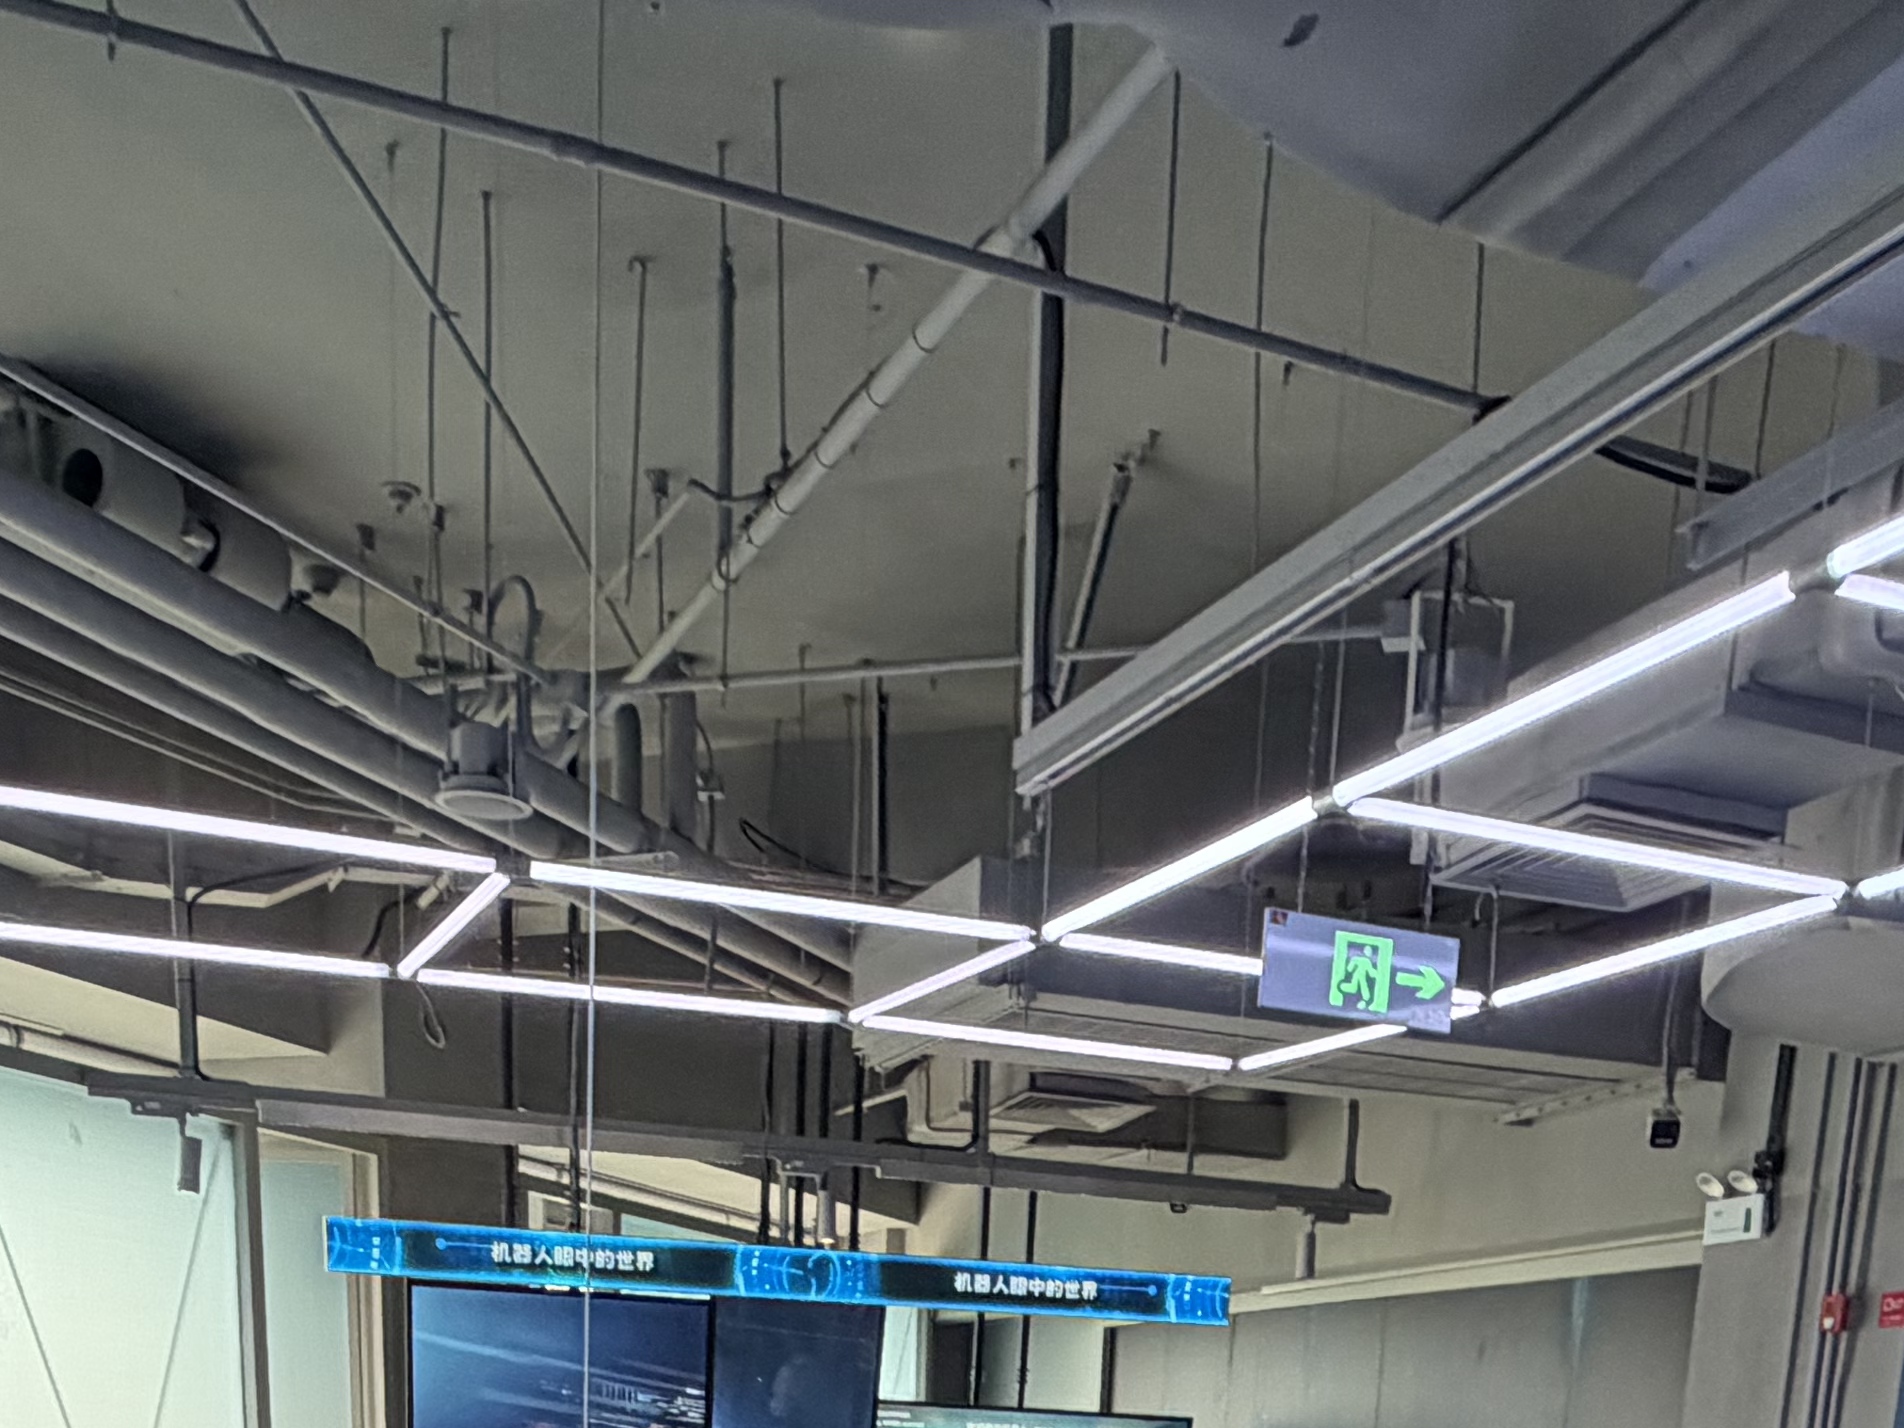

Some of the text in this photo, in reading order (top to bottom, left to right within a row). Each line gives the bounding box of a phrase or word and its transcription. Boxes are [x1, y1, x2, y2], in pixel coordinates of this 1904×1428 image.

[490, 1240, 655, 1272] 机器人眼中的世界
[953, 1271, 1098, 1301] 机器人眼中的世界
